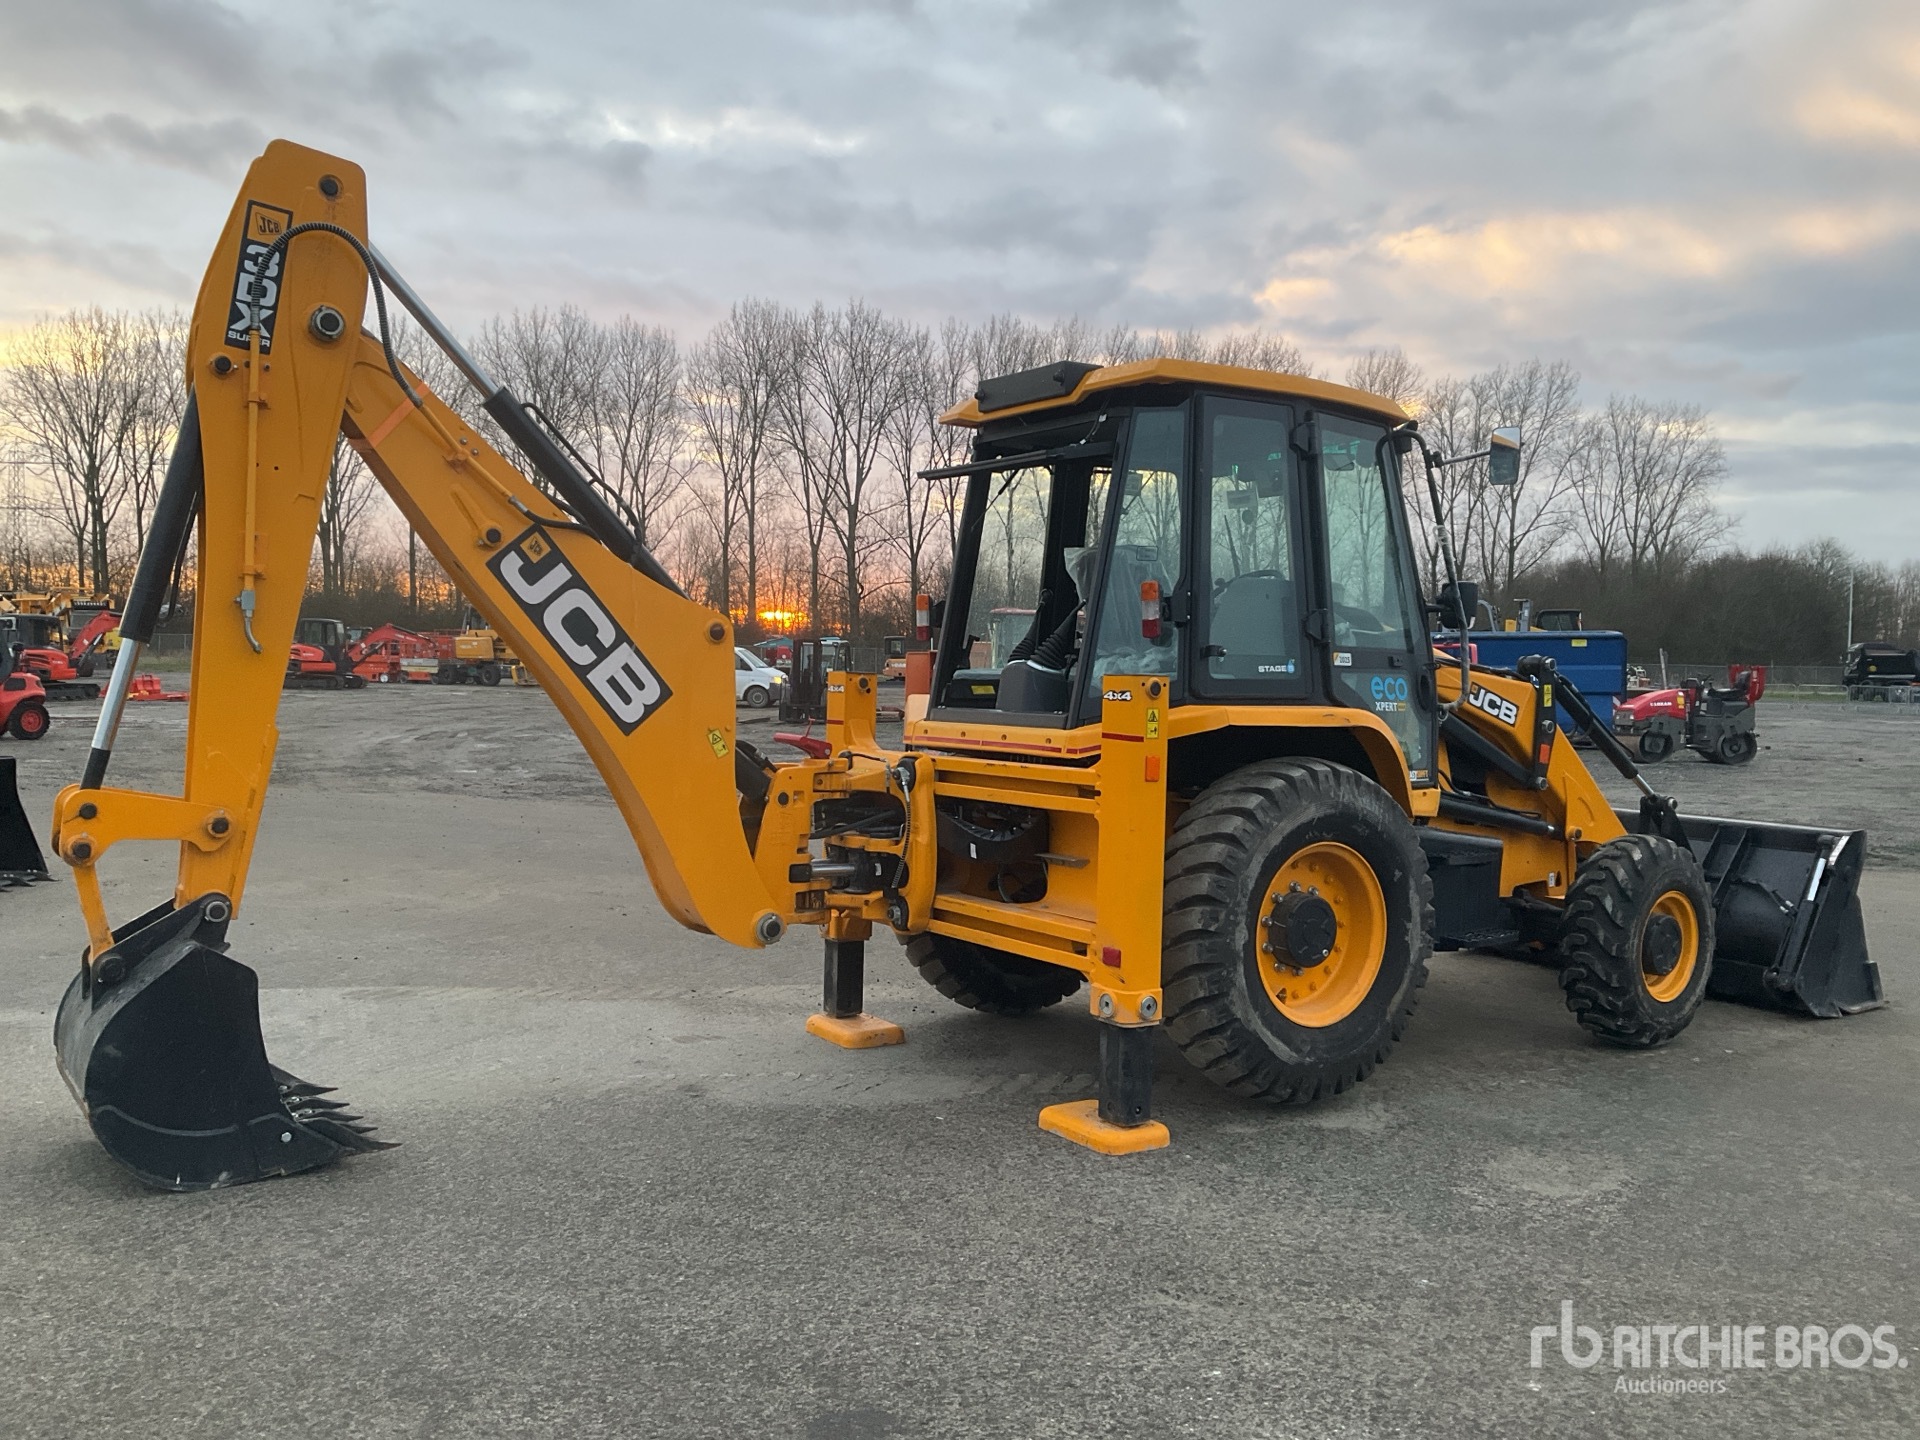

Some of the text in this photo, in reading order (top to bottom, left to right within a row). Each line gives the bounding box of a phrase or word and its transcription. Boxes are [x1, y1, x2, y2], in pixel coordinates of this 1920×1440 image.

[259, 216, 280, 233] JCB
[228, 330, 271, 347] SUPR
[500, 551, 661, 723] JCB
[1258, 665, 1287, 673] STAGE
[1103, 691, 1132, 701] 4x4
[1370, 676, 1408, 700] eco
[1375, 701, 1398, 711] XPERT
[1469, 688, 1517, 725] JCB
